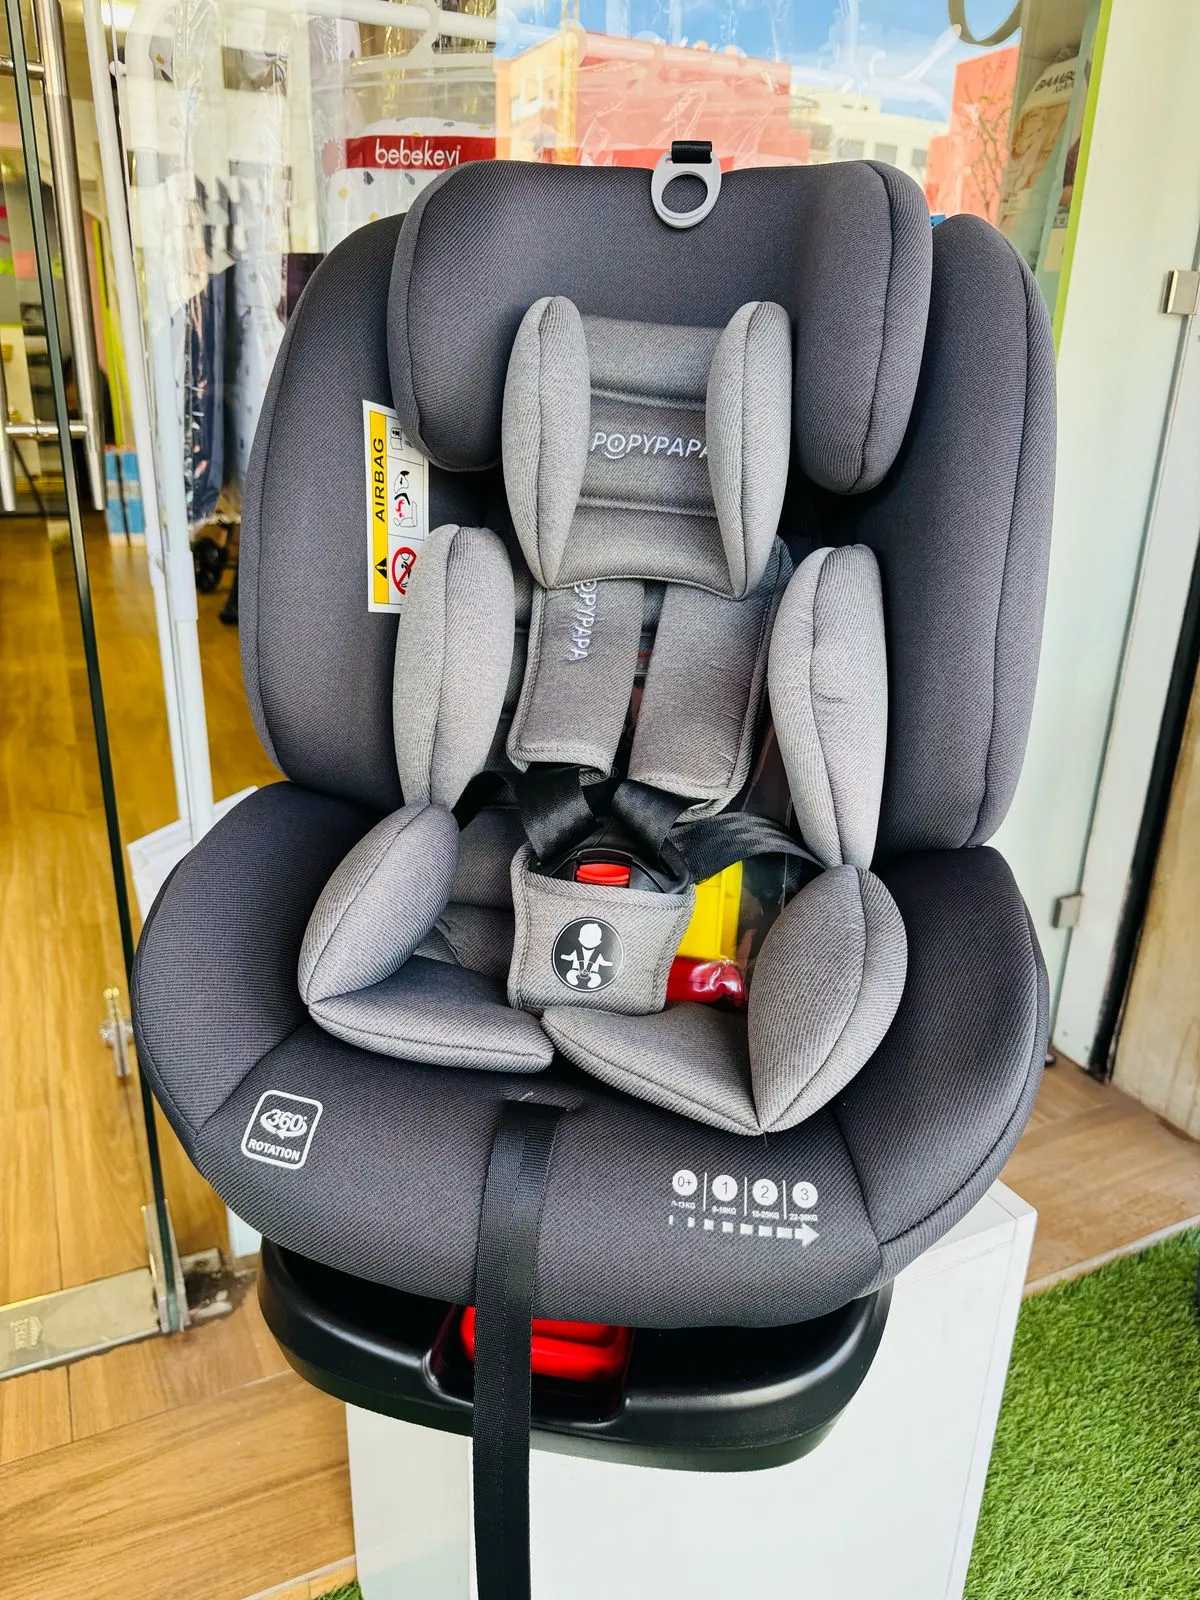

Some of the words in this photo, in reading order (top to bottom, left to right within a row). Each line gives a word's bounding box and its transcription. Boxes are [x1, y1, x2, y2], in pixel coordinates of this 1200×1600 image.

[375, 138, 461, 165] bebekevi
[373, 438, 385, 522] AIRBAG
[570, 580, 597, 661] OPYPAPA
[248, 1138, 301, 1161] ROTATION
[677, 1175, 693, 1187] 0+
